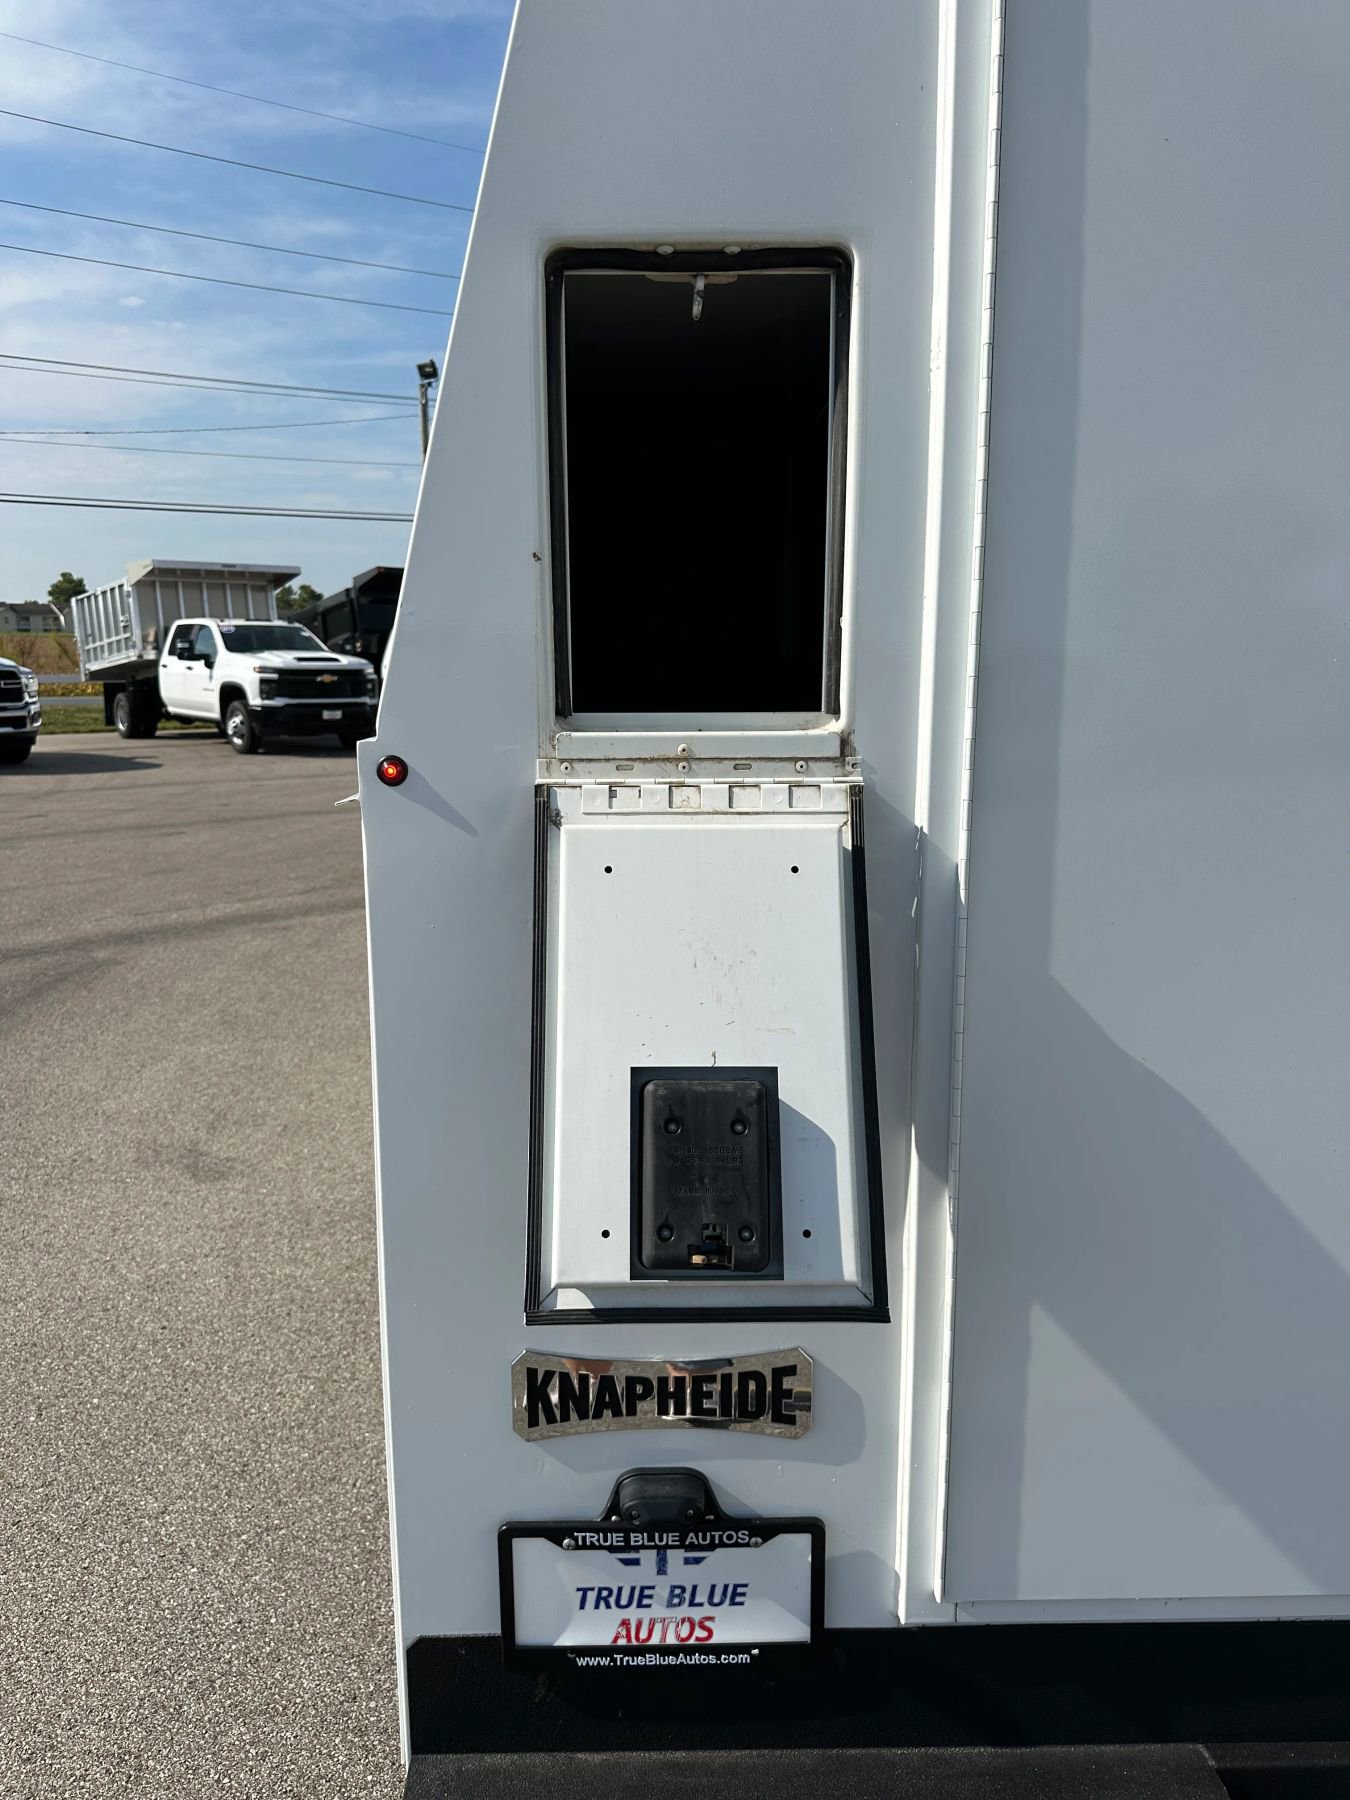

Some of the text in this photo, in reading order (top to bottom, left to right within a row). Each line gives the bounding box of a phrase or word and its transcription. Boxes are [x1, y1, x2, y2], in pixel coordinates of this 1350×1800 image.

[526, 1364, 797, 1428] KNAPHEIDE
[574, 1530, 749, 1546] TRUE BLUE AUTOS
[576, 1583, 749, 1610] TRUE BLUE
[611, 1616, 716, 1644] AUTOS
[576, 1653, 750, 1666] www.TrueBlueAutos.com
